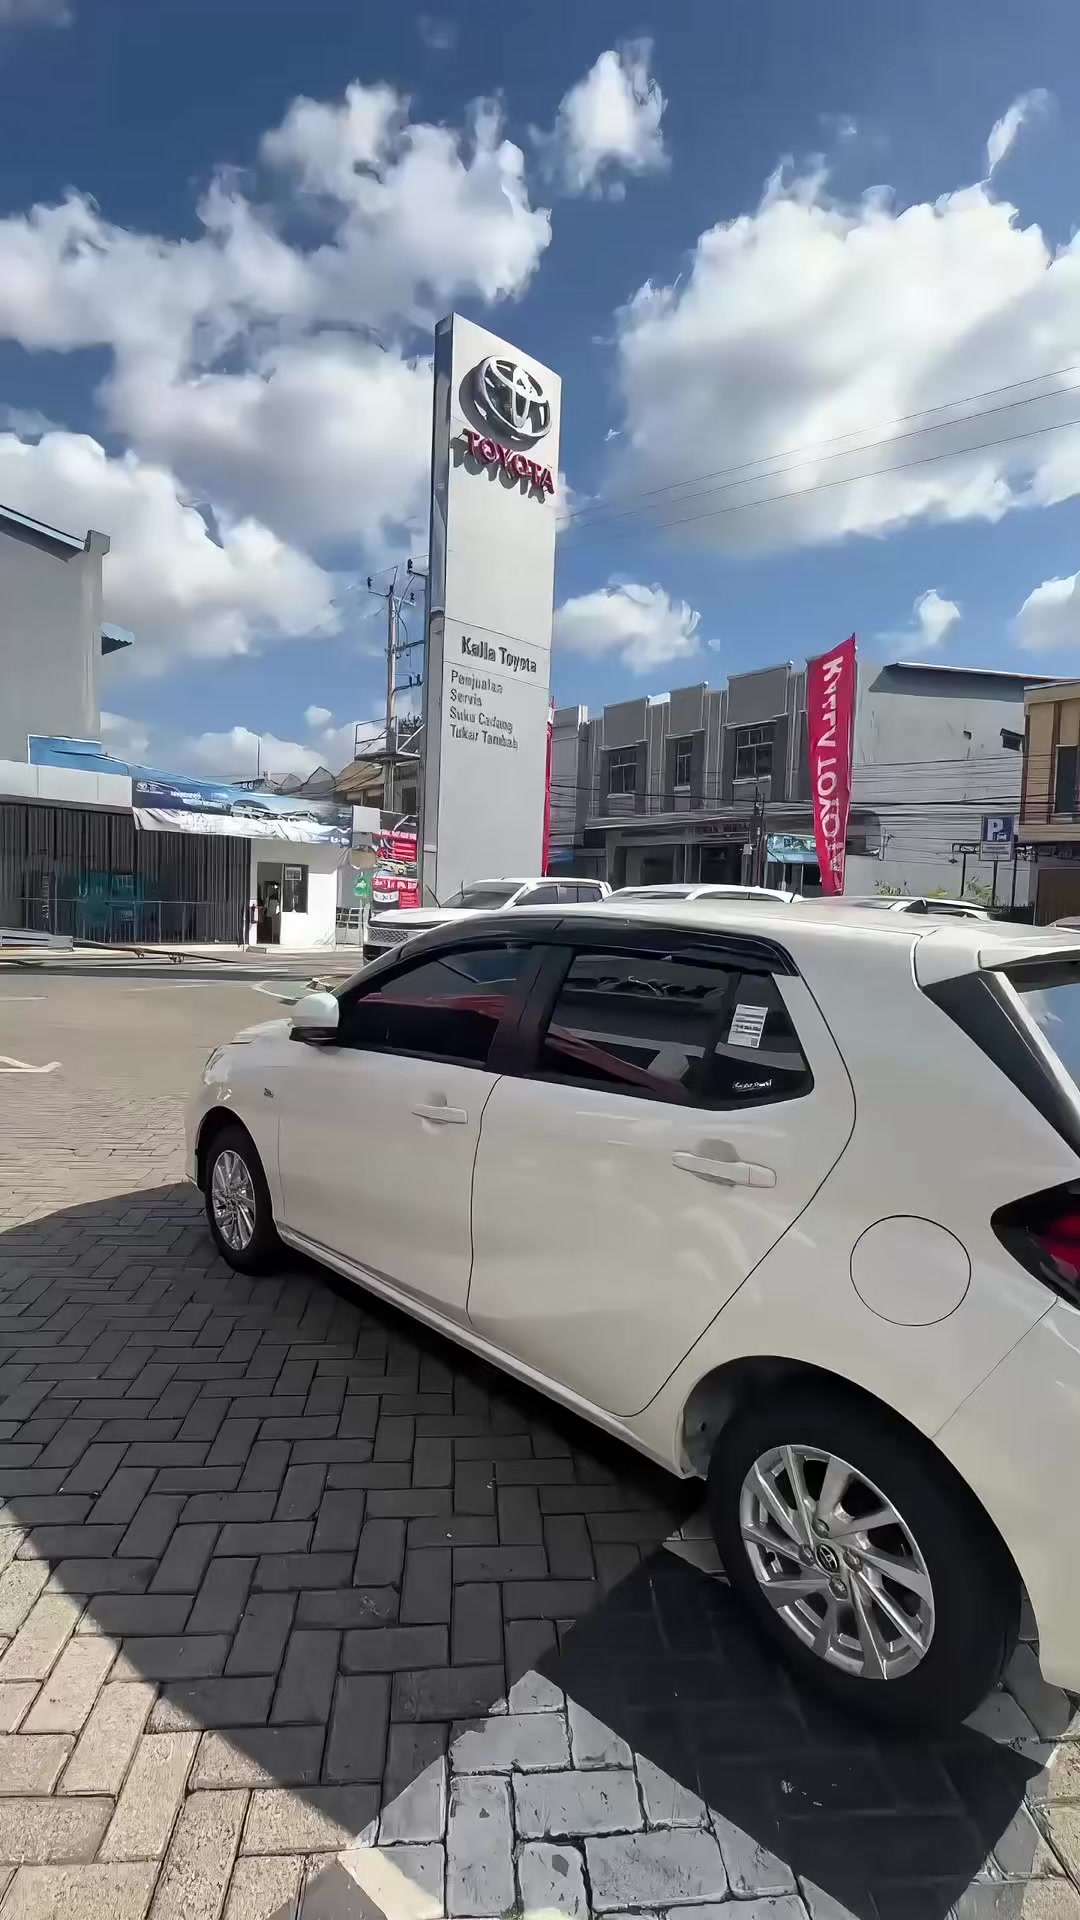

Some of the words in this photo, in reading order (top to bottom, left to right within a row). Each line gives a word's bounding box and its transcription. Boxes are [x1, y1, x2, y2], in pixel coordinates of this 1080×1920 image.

[463, 428, 555, 495] TOYOTA
[461, 635, 496, 662] Kalla
[498, 646, 537, 673] Toyota
[451, 669, 503, 694] Penjualan
[450, 688, 482, 707] Servis
[450, 705, 476, 723] Suku
[478, 712, 513, 734] Cadang
[450, 723, 479, 742] Tukar
[482, 730, 518, 751] Tambah
